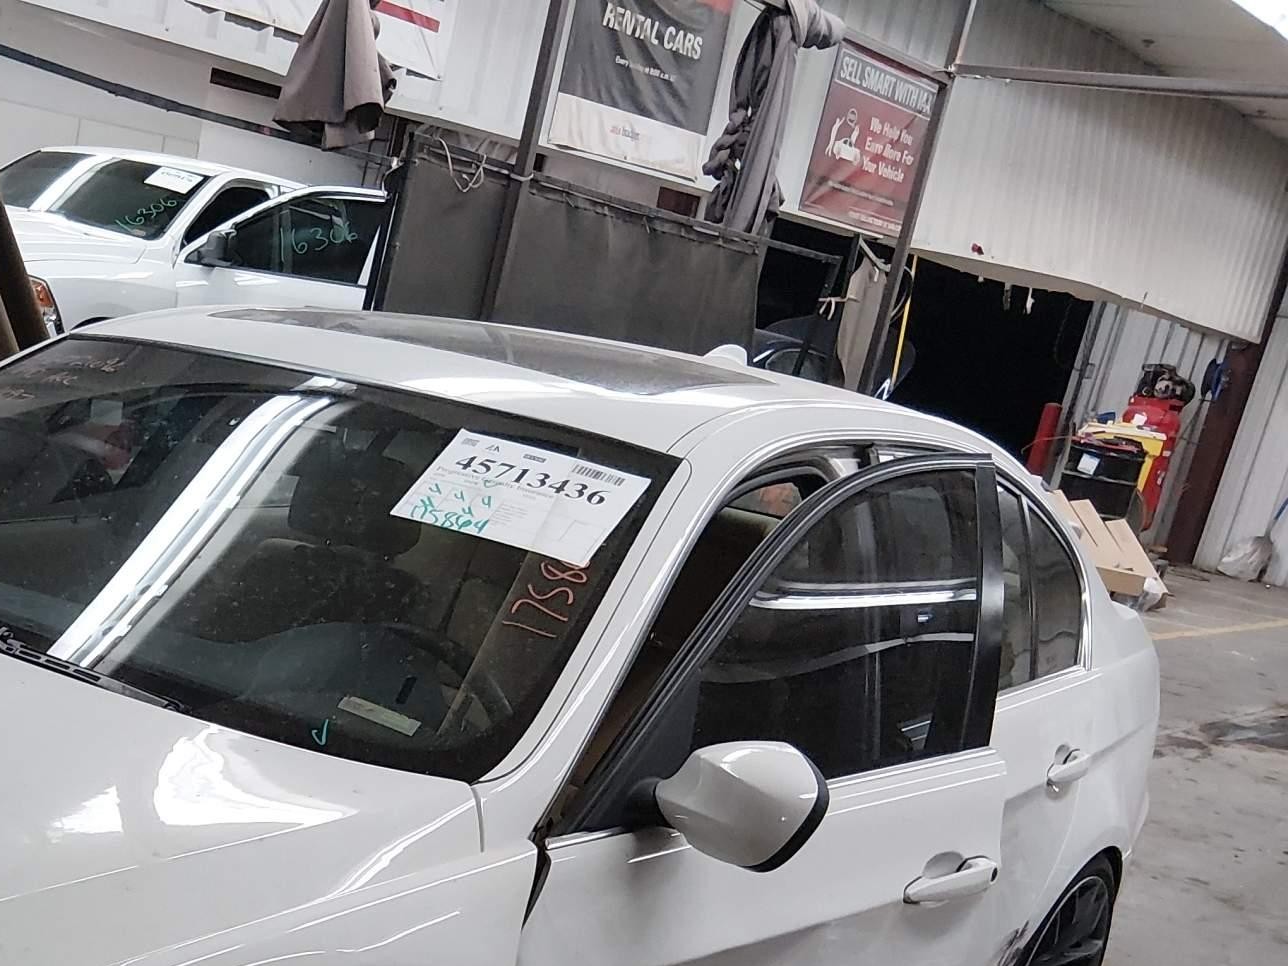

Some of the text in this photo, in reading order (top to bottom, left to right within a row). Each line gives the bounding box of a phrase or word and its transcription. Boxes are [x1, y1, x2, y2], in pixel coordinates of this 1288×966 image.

[602, 2, 703, 60] RENTAL CARS
[840, 56, 862, 85] SELL
[862, 66, 896, 98] SMART
[894, 80, 920, 108] WITH
[870, 117, 914, 146] We Help You
[862, 156, 904, 183] Your Vehicle
[116, 198, 177, 232] 16306
[279, 224, 358, 263] 16306
[455, 455, 611, 507] 45713436
[502, 560, 590, 638] 1758
